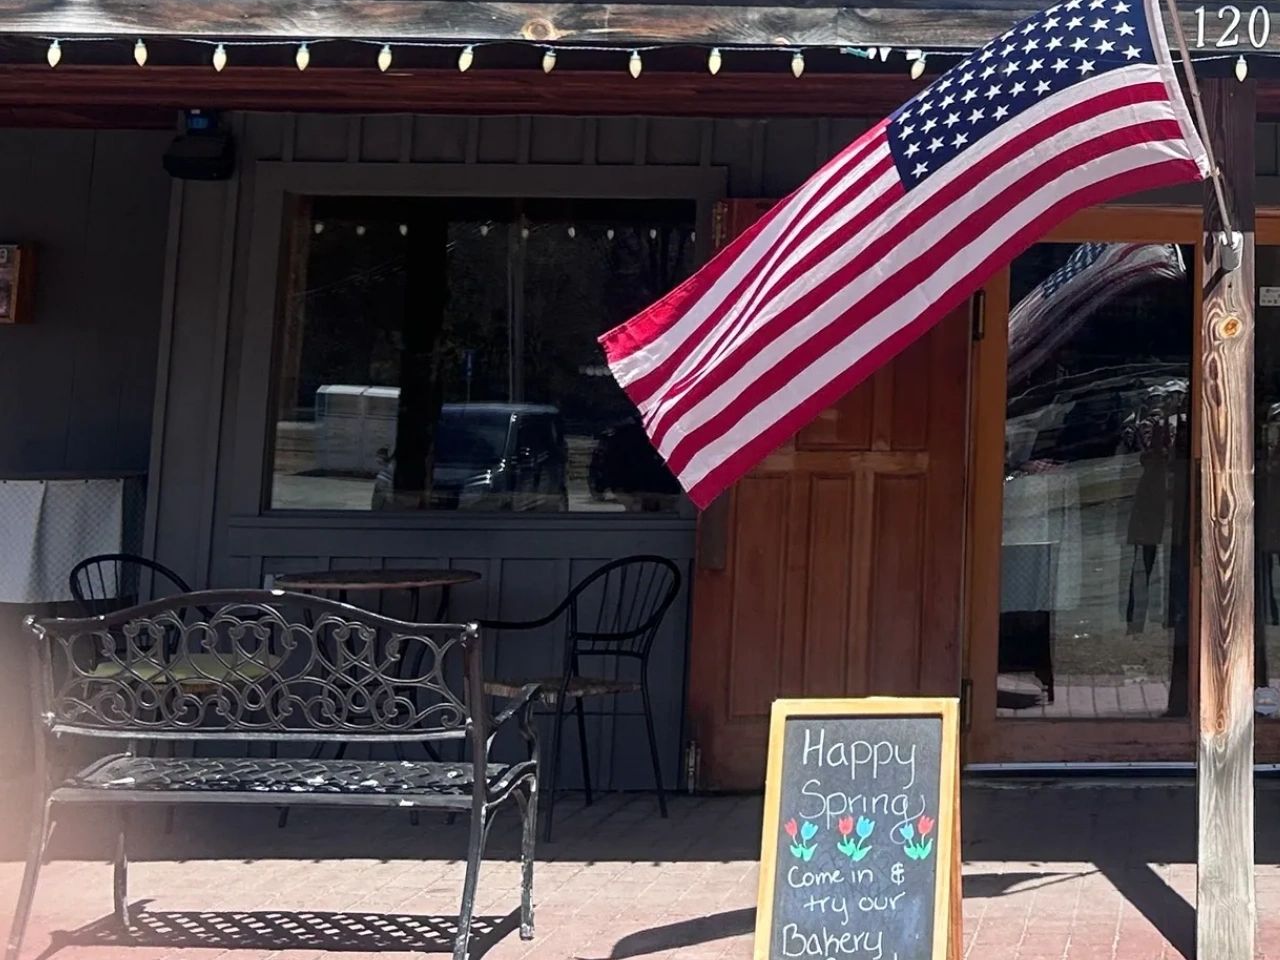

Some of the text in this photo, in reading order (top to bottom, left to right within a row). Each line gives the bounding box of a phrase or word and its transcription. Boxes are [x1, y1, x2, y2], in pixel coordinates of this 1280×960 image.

[1194, 5, 1271, 49] 120
[802, 728, 917, 789] Happy
[799, 779, 926, 845] Spring
[787, 865, 844, 888] Come
[851, 866, 874, 883] in
[803, 892, 906, 925] try our
[782, 923, 883, 960] Bakery
